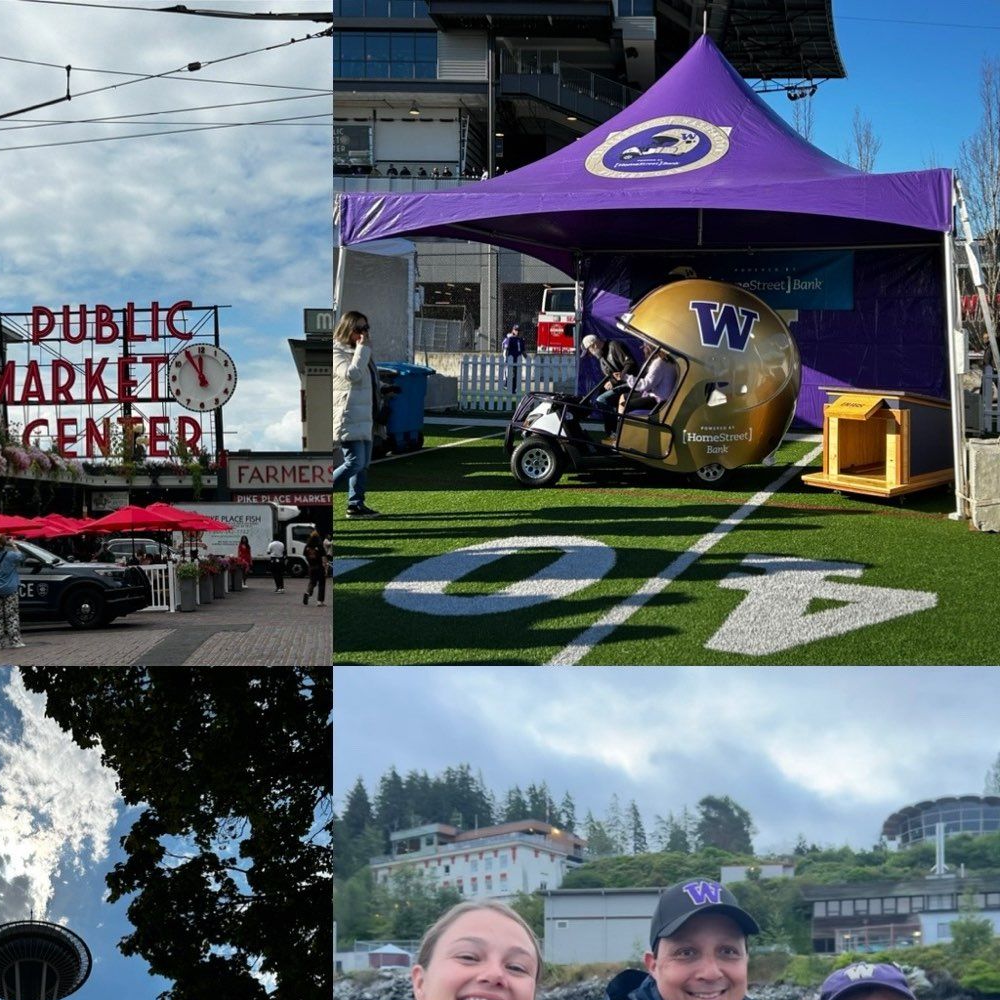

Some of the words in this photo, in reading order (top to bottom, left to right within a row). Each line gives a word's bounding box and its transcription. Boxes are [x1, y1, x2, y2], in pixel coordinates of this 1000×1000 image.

[793, 278, 824, 290] Bank
[32, 300, 193, 345] PUBLIC
[689, 300, 760, 352] W
[706, 445, 728, 454] Bank
[237, 495, 258, 503] PIKE
[294, 495, 332, 503] MARKET
[683, 881, 722, 905] W
[844, 962, 876, 979] W
